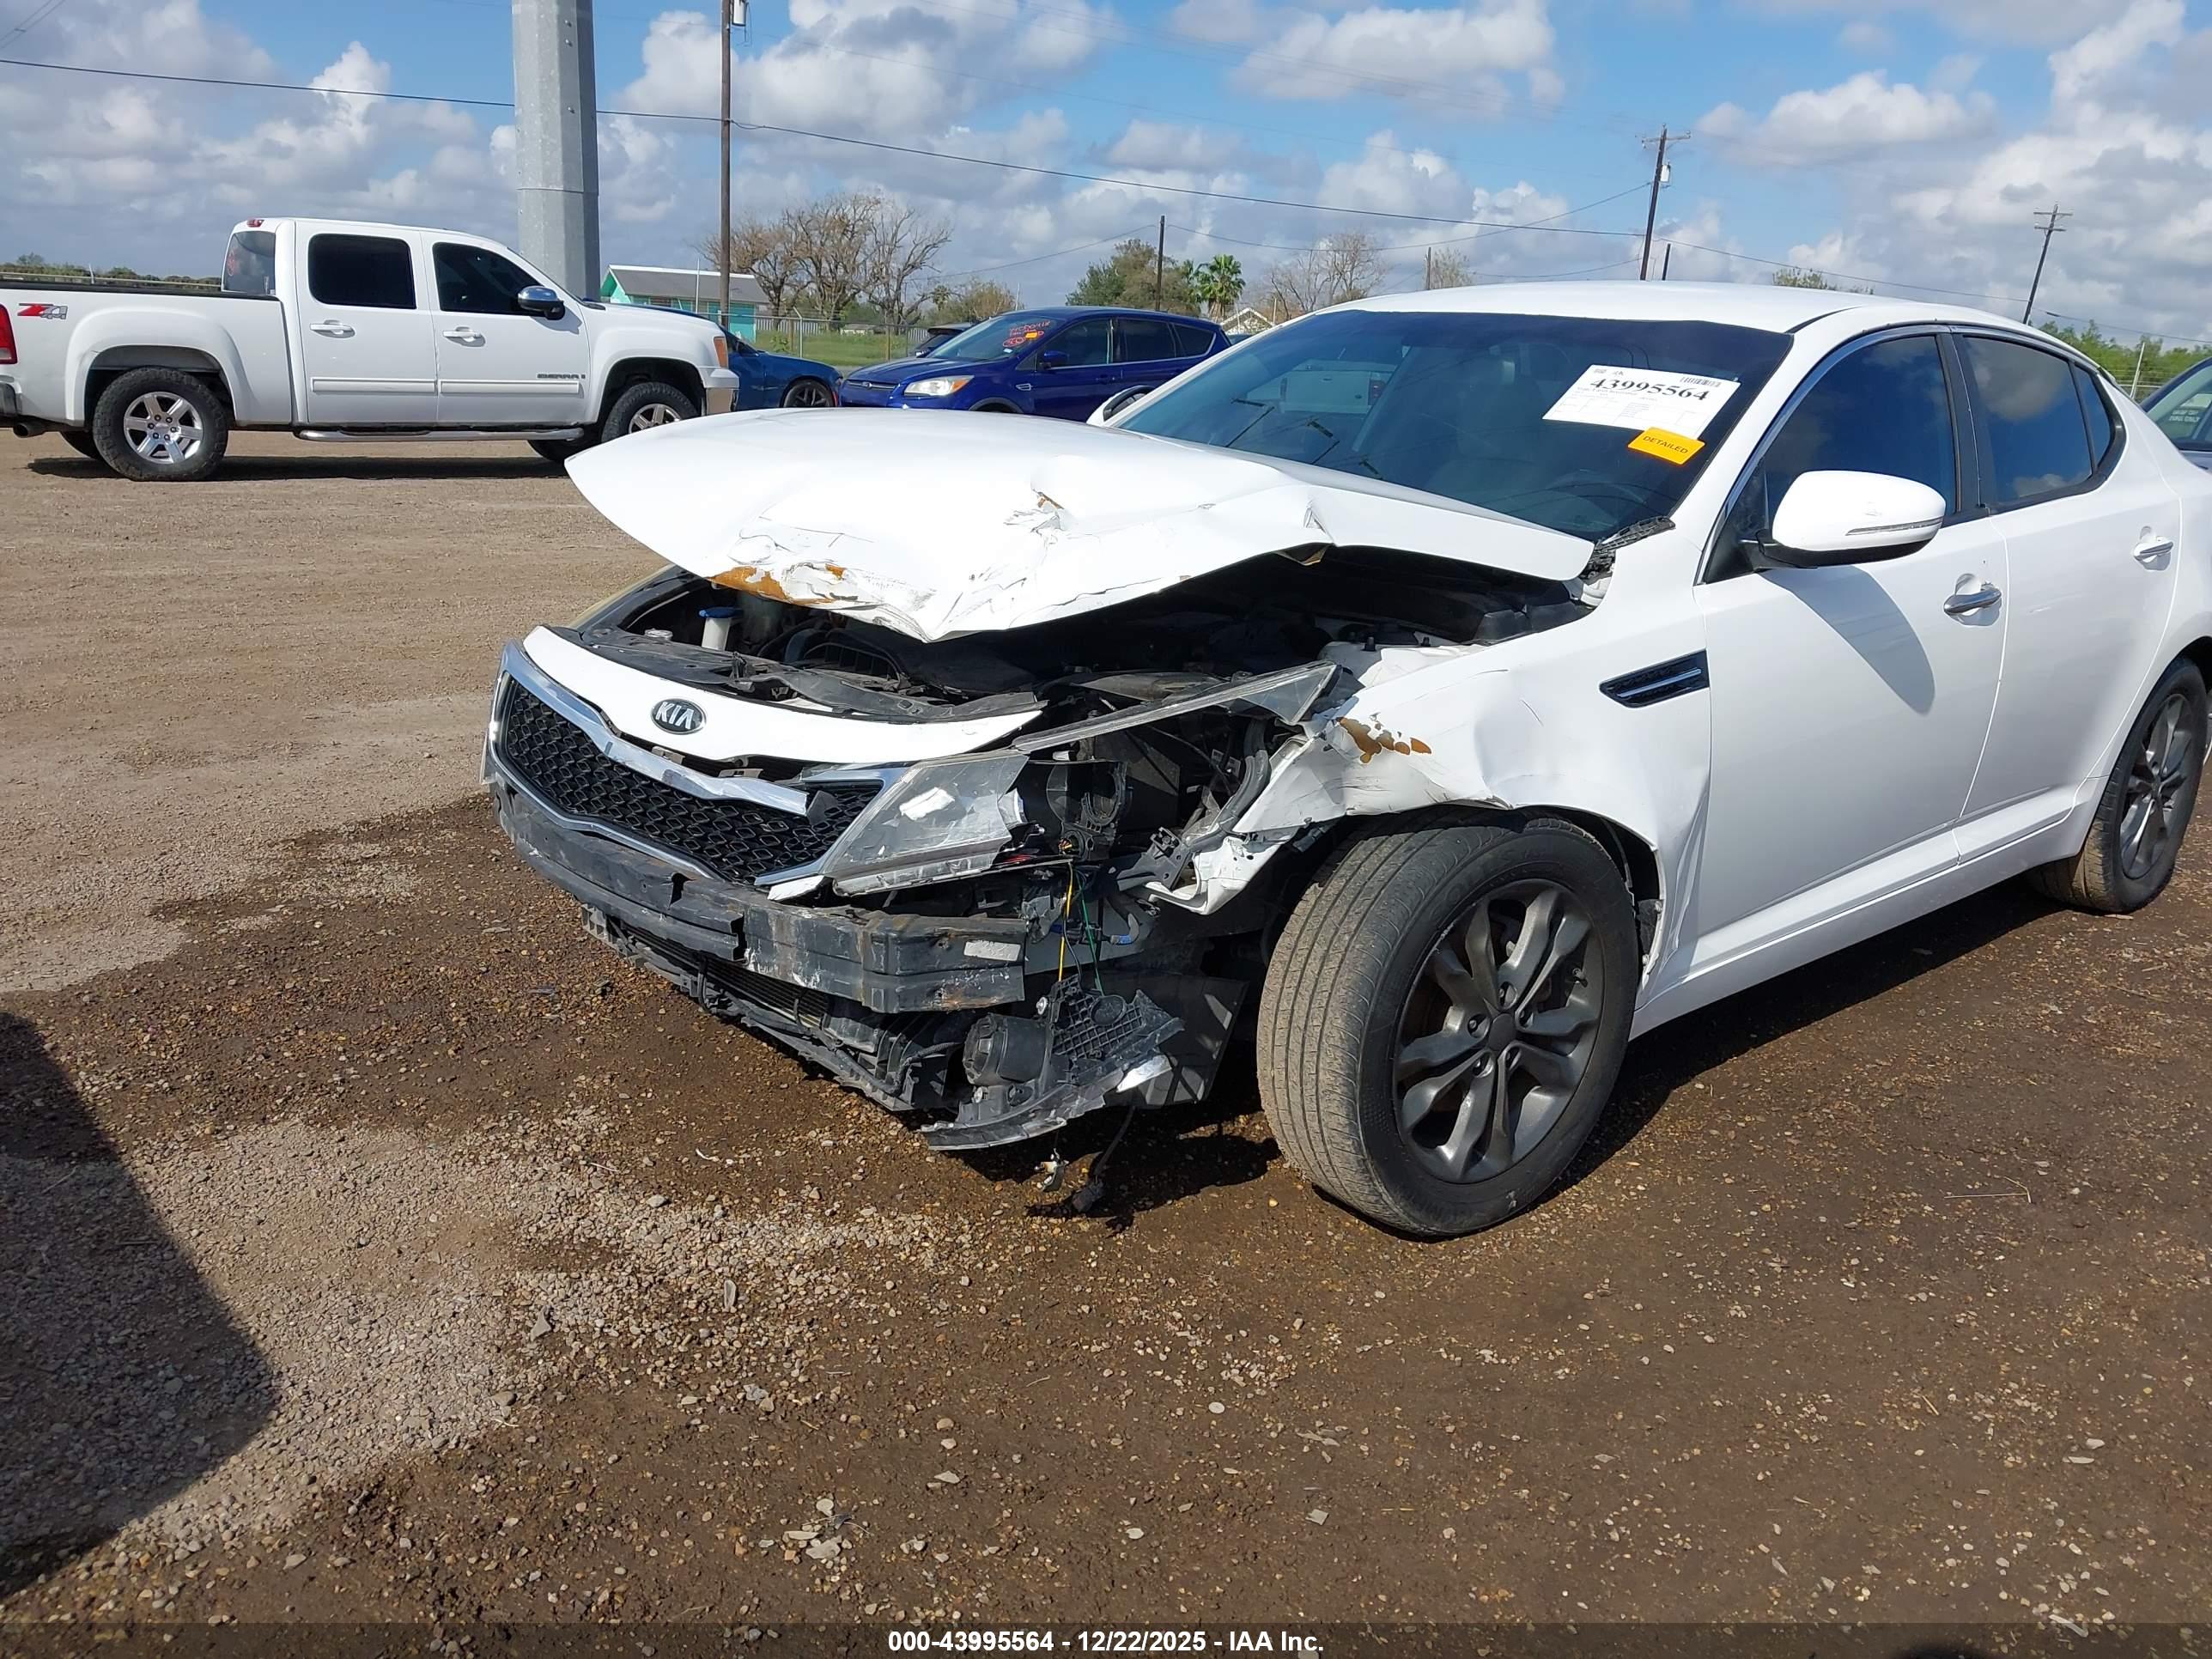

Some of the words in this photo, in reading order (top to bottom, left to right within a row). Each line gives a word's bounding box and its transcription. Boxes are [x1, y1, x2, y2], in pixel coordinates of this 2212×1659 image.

[1590, 378, 1711, 401] 43995564
[1643, 435, 1689, 454] DETAILED
[655, 701, 694, 730] KIA
